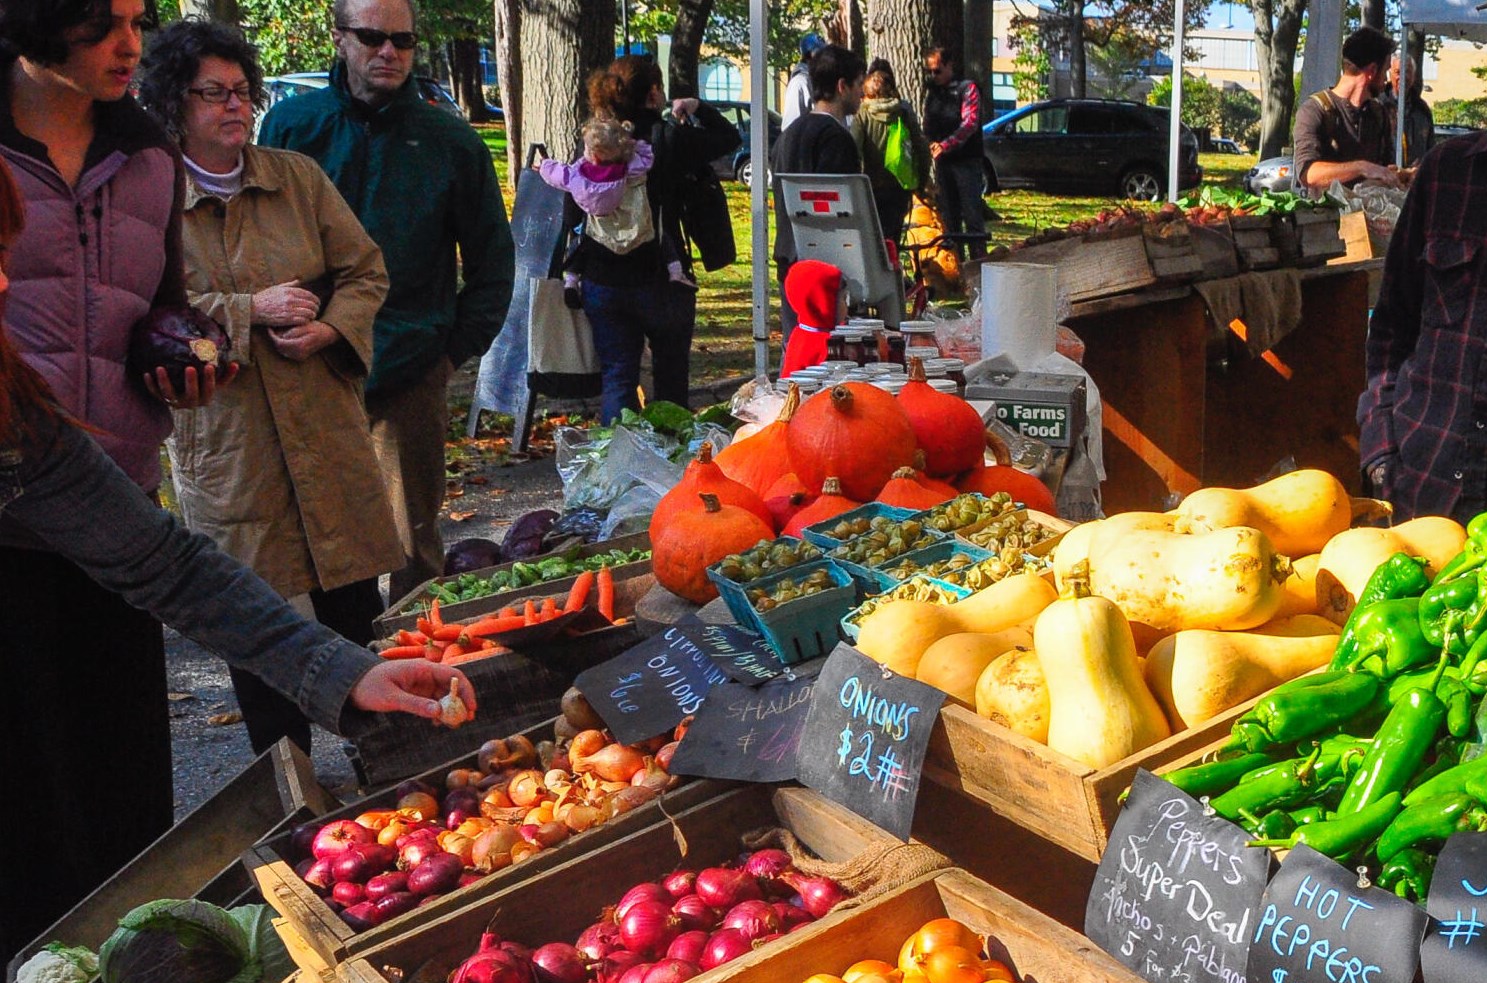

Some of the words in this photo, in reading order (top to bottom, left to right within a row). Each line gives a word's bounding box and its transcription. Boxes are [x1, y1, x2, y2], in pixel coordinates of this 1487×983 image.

[998, 407, 1007, 418] o
[1013, 405, 1065, 420] Farms
[1019, 422, 1060, 437] Food
[648, 654, 705, 714] ONIONS
[840, 676, 920, 741] ONIONS
[1121, 835, 1184, 901] Super
[1187, 880, 1250, 944] Deal
[1295, 875, 1374, 930] HOT
